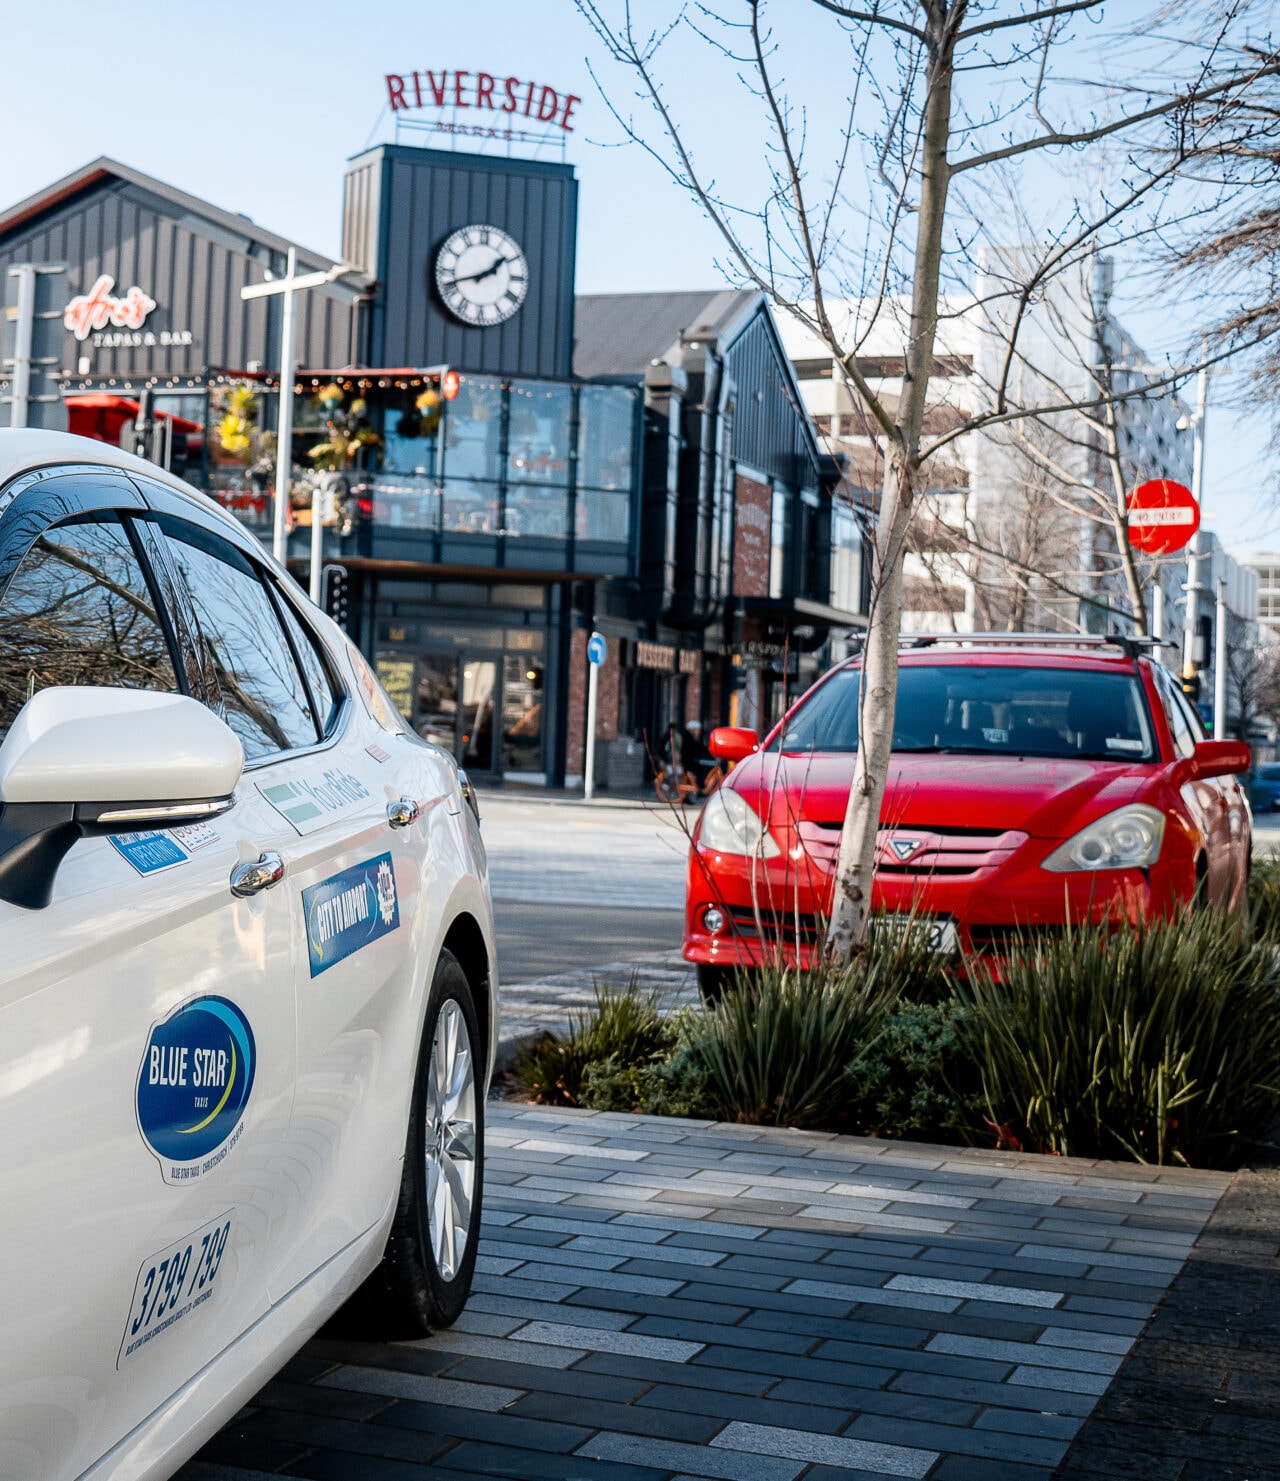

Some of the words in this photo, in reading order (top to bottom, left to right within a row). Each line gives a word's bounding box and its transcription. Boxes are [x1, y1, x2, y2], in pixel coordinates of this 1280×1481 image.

[386, 70, 582, 132] RIVERSIDE
[93, 332, 142, 348] TAPAS
[144, 331, 156, 346] &
[160, 331, 192, 346] BAR
[1136, 511, 1149, 522] NO
[1154, 511, 1183, 522] ENTRY
[297, 768, 370, 812] YourRide
[317, 900, 334, 944] CITY
[332, 895, 344, 934] TO
[149, 1045, 189, 1086] BLUE
[193, 1047, 226, 1087] STAR
[131, 1245, 192, 1335] 3799
[187, 1220, 231, 1297] 799
